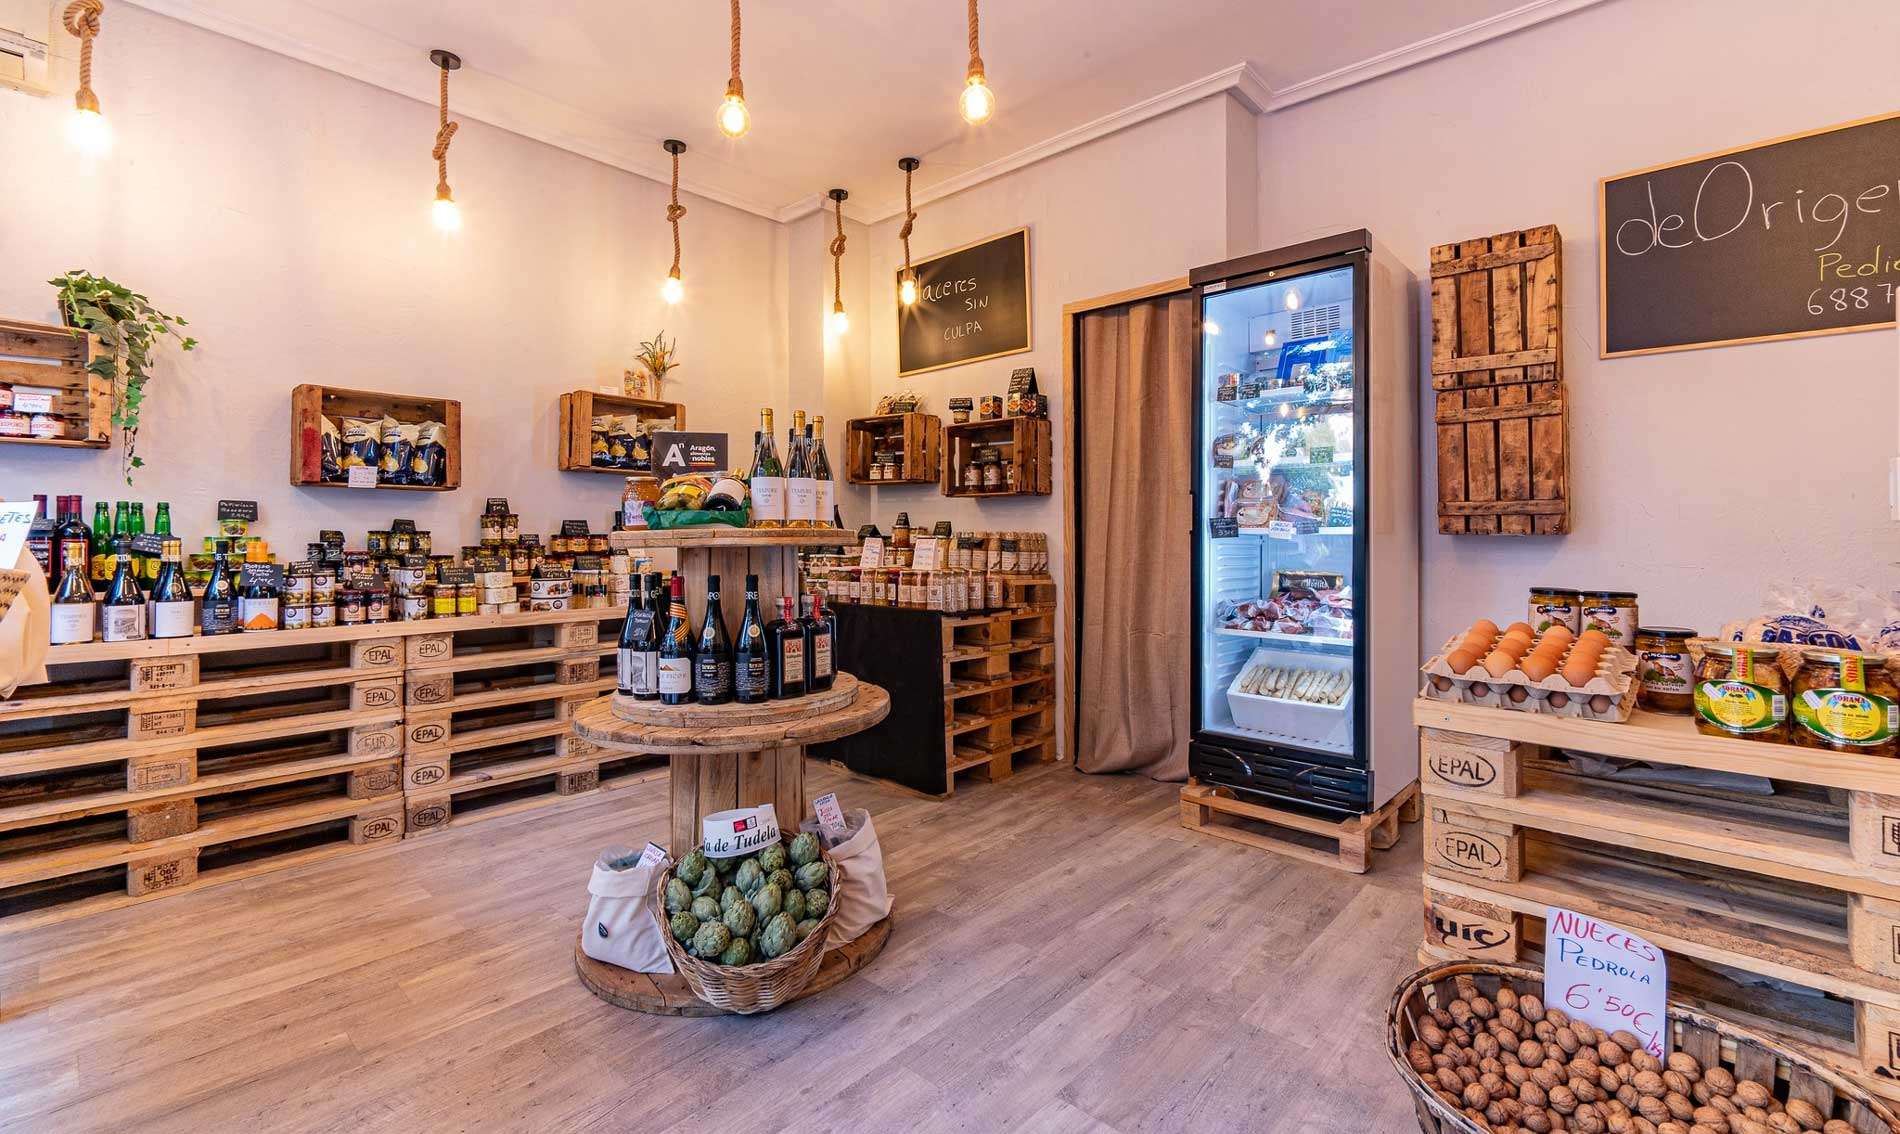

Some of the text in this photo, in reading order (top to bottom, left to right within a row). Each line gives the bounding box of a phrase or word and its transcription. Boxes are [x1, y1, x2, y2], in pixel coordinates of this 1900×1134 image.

[1616, 161, 1900, 256] deOrige
[911, 275, 977, 303] laceres
[964, 295, 989, 312] SIN
[943, 320, 983, 341] CULPA
[368, 649, 392, 662] EPAL
[419, 644, 442, 655] EPAL
[365, 691, 390, 703] EPAL
[419, 687, 442, 699] EPAL
[415, 728, 439, 740] EPAL
[415, 770, 439, 782] EPAL
[1437, 755, 1485, 782] EPAL
[417, 810, 440, 824] EPAL
[367, 821, 393, 836] EPAL
[714, 838, 729, 852] de
[733, 825, 777, 850] Tudela
[1445, 837, 1493, 865] EPAL
[1552, 911, 1656, 962] NUECES
